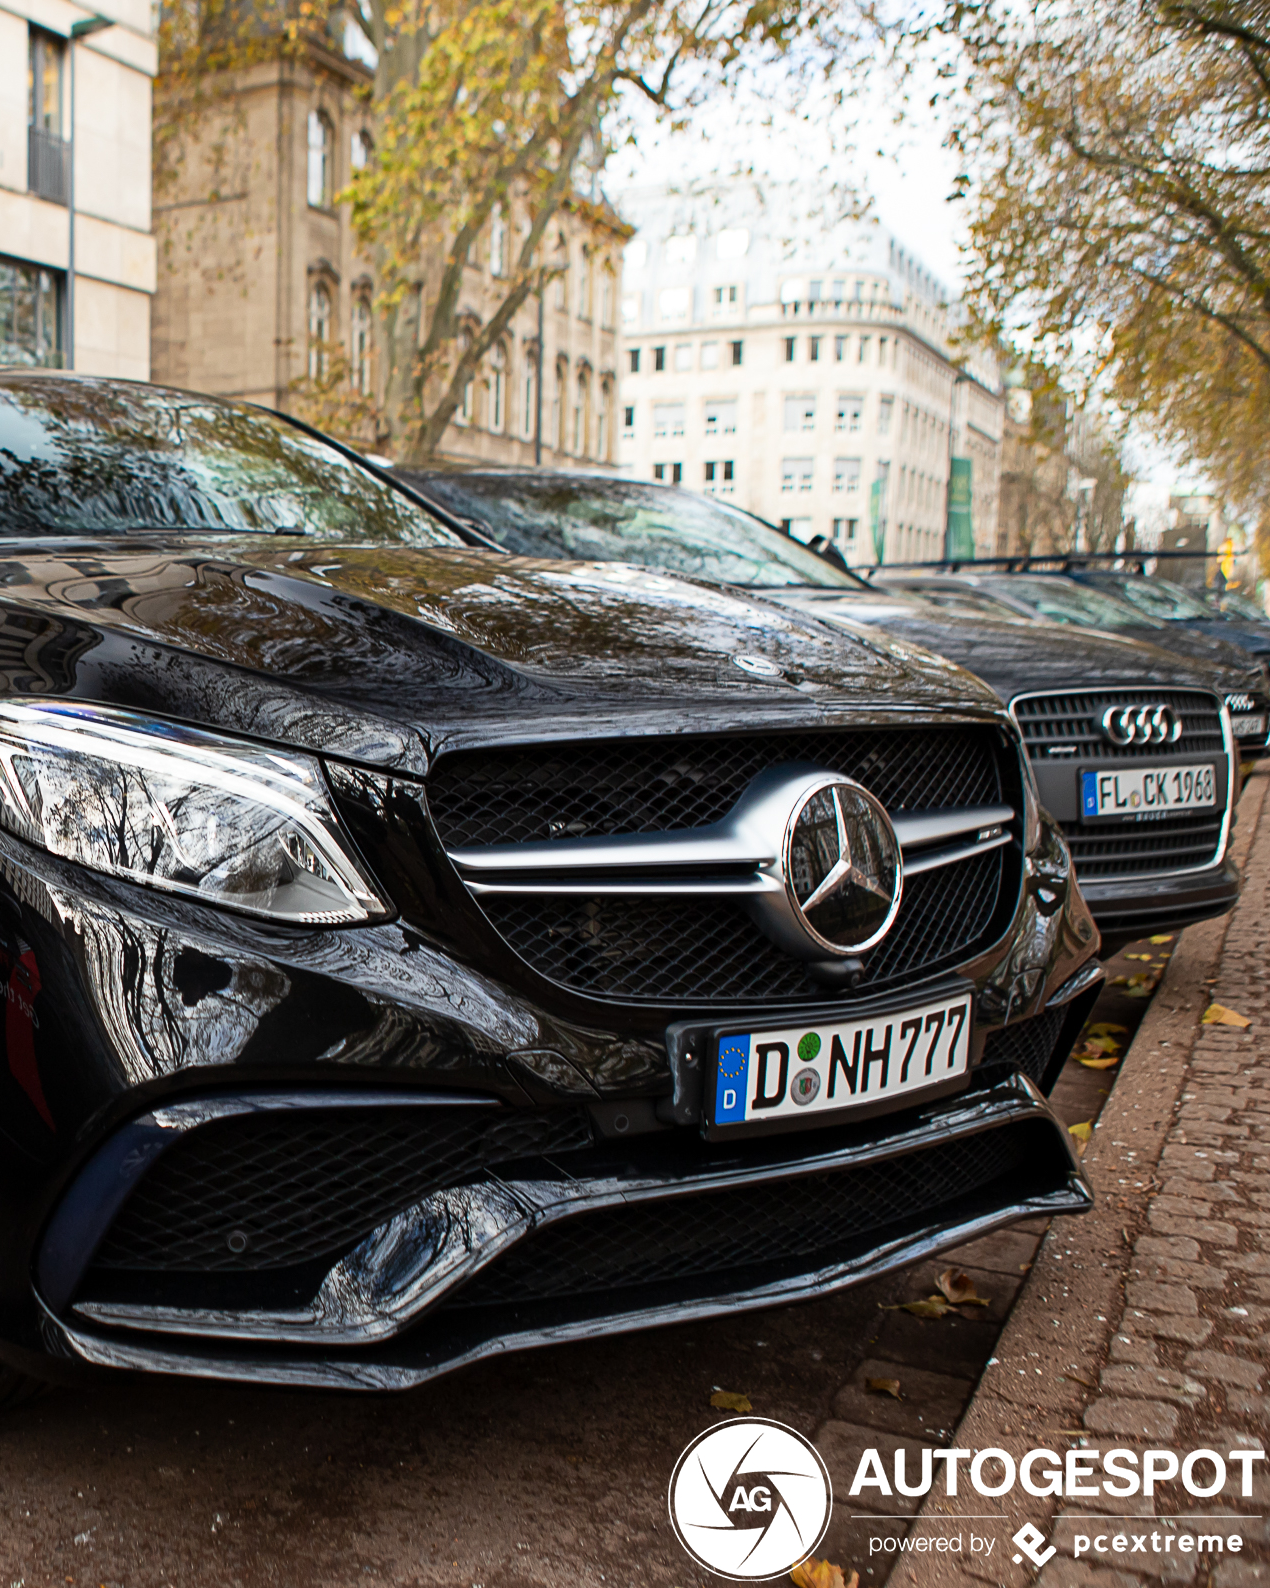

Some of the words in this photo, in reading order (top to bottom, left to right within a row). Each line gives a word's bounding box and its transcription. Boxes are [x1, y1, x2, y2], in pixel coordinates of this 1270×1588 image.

[1098, 775, 1128, 809] FL
[1142, 772, 1169, 806] CK
[1172, 768, 1213, 803] 1968
[723, 1088, 737, 1110] D
[751, 1041, 790, 1111] D
[826, 1024, 894, 1099] NH
[899, 1003, 968, 1083] 777
